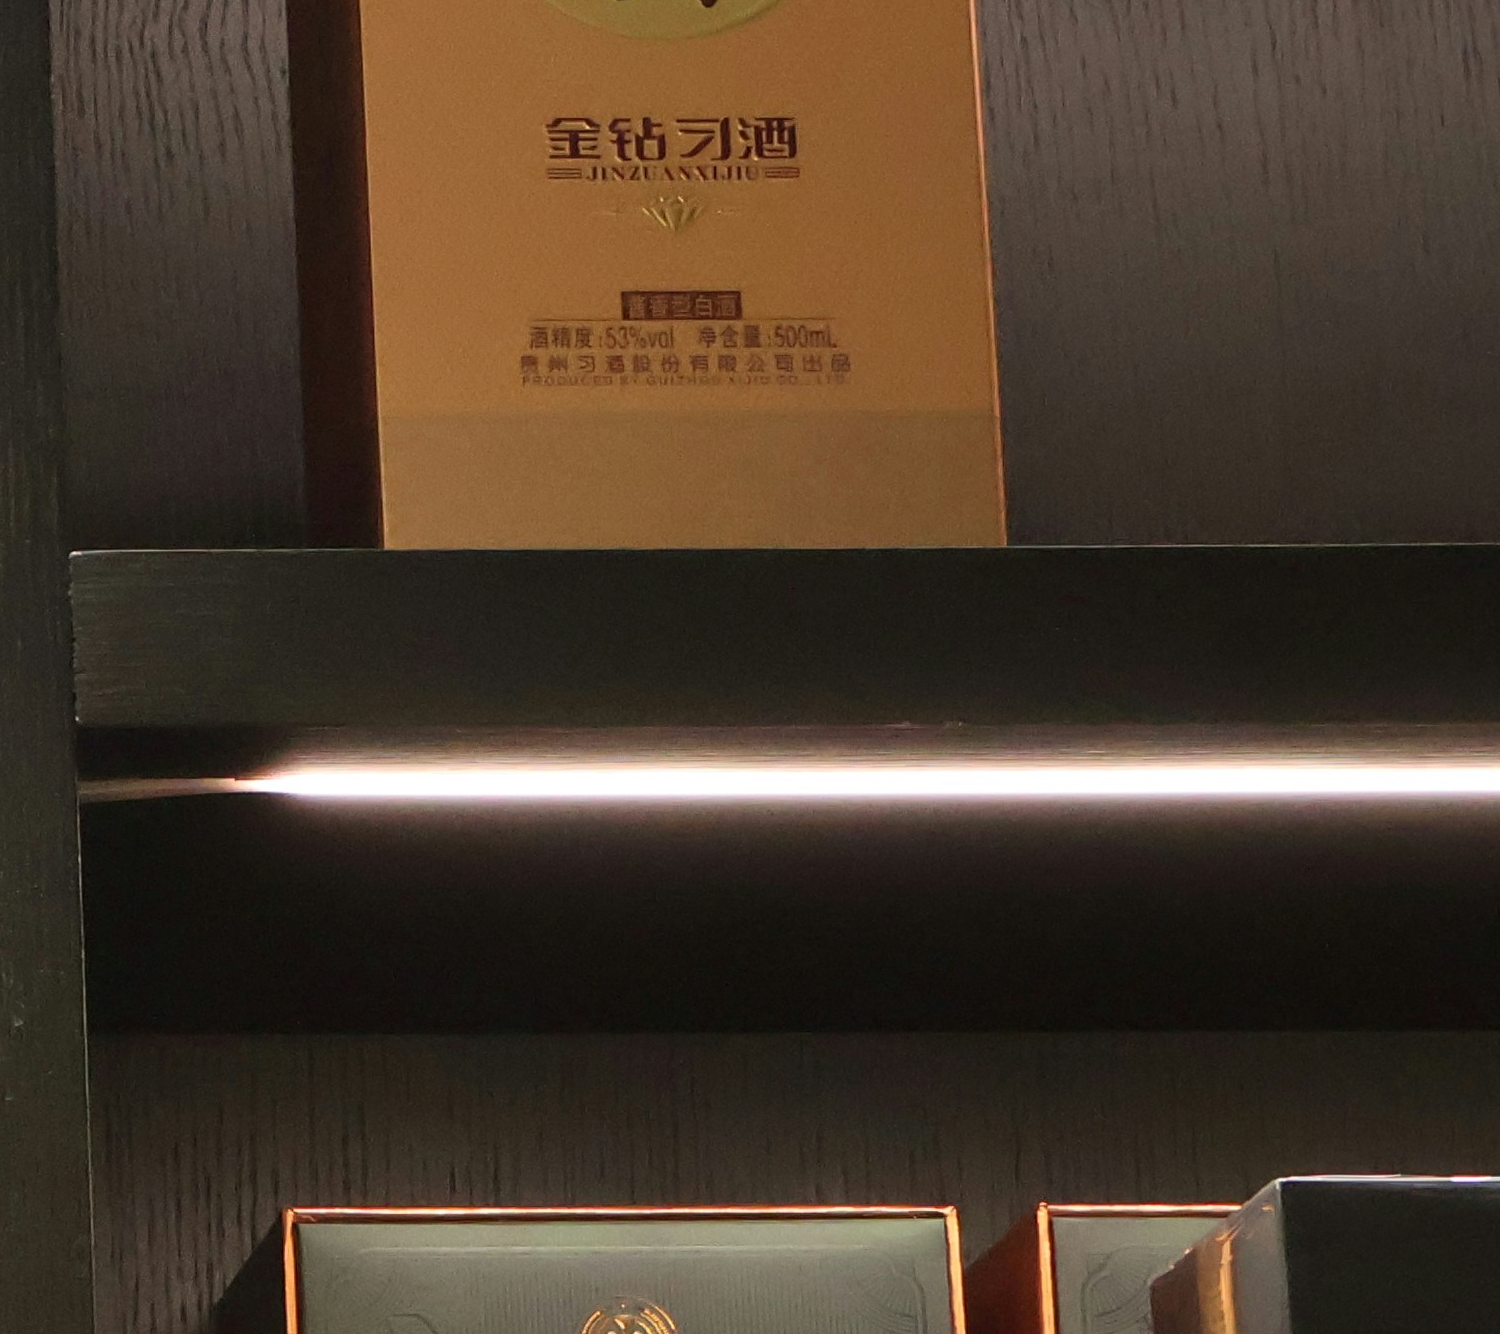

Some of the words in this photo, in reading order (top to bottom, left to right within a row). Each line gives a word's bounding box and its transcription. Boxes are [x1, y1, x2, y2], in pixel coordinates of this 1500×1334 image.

[546, 117, 796, 161] 金钻习酒
[587, 166, 759, 181] JINZUANXIJIU
